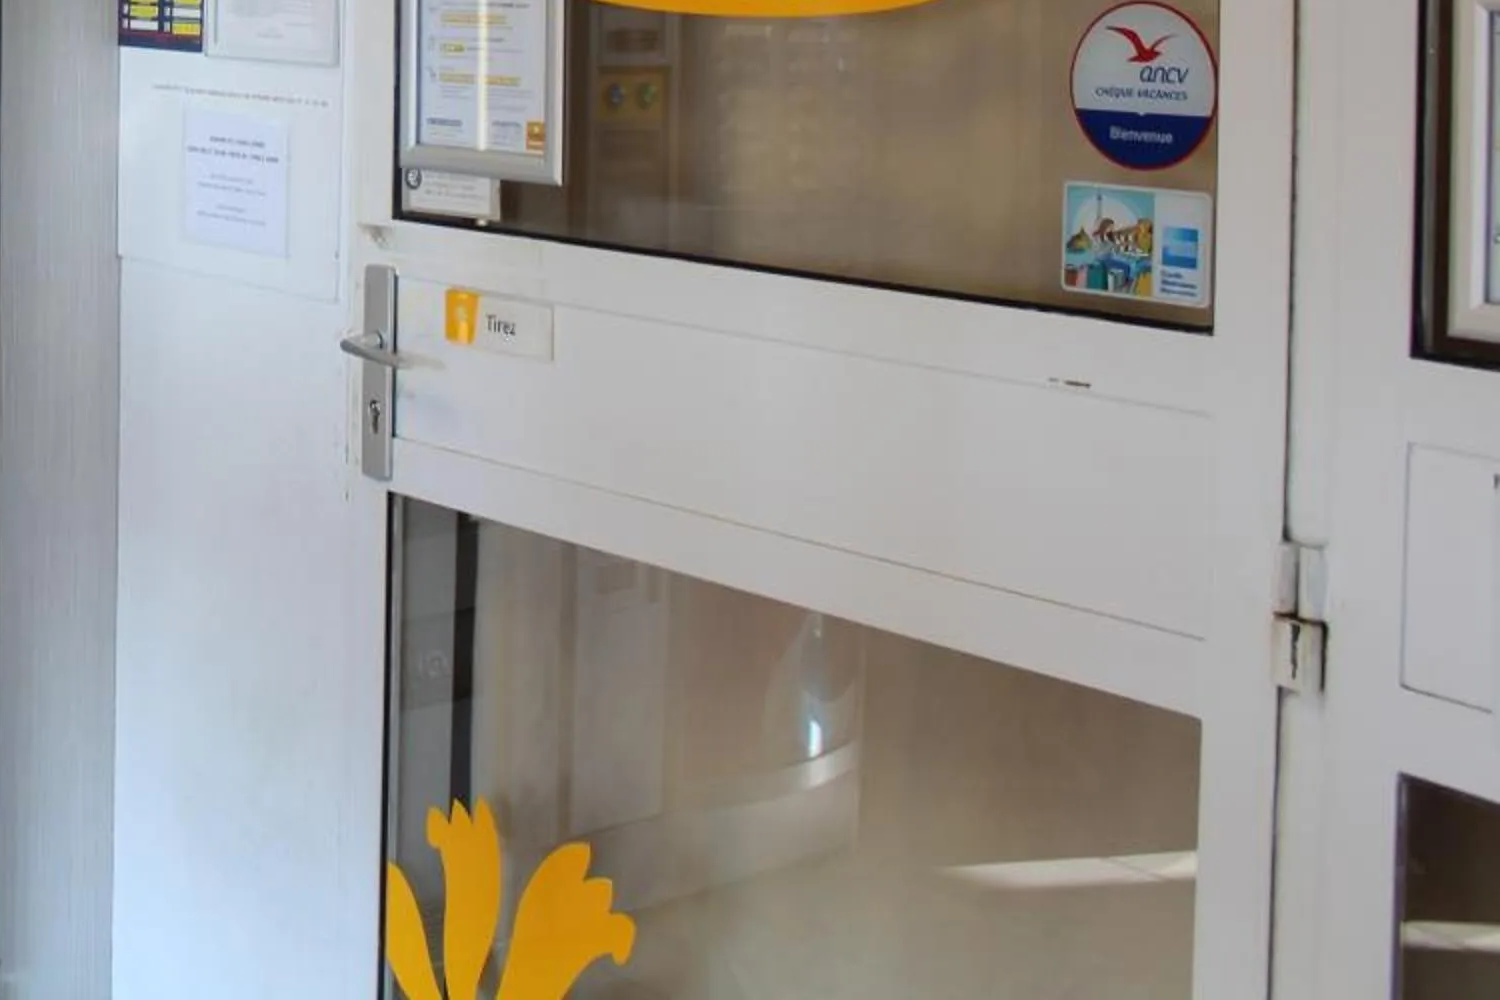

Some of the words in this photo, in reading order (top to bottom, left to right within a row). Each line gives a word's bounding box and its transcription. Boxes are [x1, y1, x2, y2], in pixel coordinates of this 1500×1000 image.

[1139, 65, 1189, 84] ancv
[1109, 125, 1174, 144] Bienvenue
[485, 313, 517, 337] Tirez
